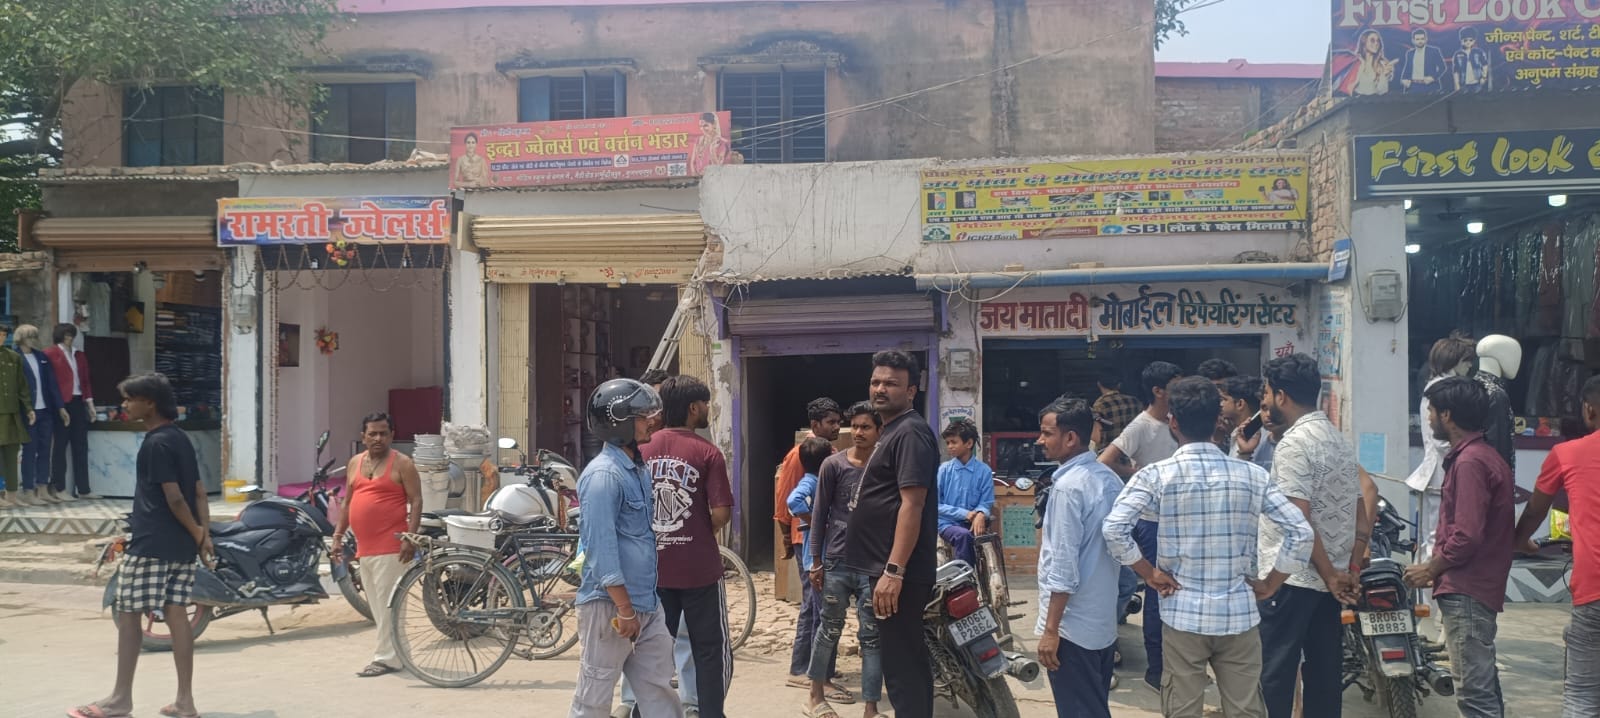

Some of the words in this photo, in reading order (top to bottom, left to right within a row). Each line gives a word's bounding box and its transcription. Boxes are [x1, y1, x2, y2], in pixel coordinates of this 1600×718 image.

[1339, 0, 1446, 26] First
[1454, 0, 1566, 22] Look
[1484, 27, 1522, 43] जीन्स
[1505, 46, 1524, 62] एवं
[1515, 66, 1561, 85] अनुपम
[1563, 62, 1599, 80] संग्रह
[524, 133, 573, 157] ज्वेलर्स
[578, 132, 601, 155] एवं
[648, 127, 689, 149] भंडार
[1370, 139, 1479, 182] First
[226, 202, 333, 240] रामरती
[340, 199, 448, 240] ज्वेलर्स
[1126, 223, 1166, 234] SBI
[1169, 221, 1196, 233] लोन
[1368, 611, 1406, 624] BR06C
